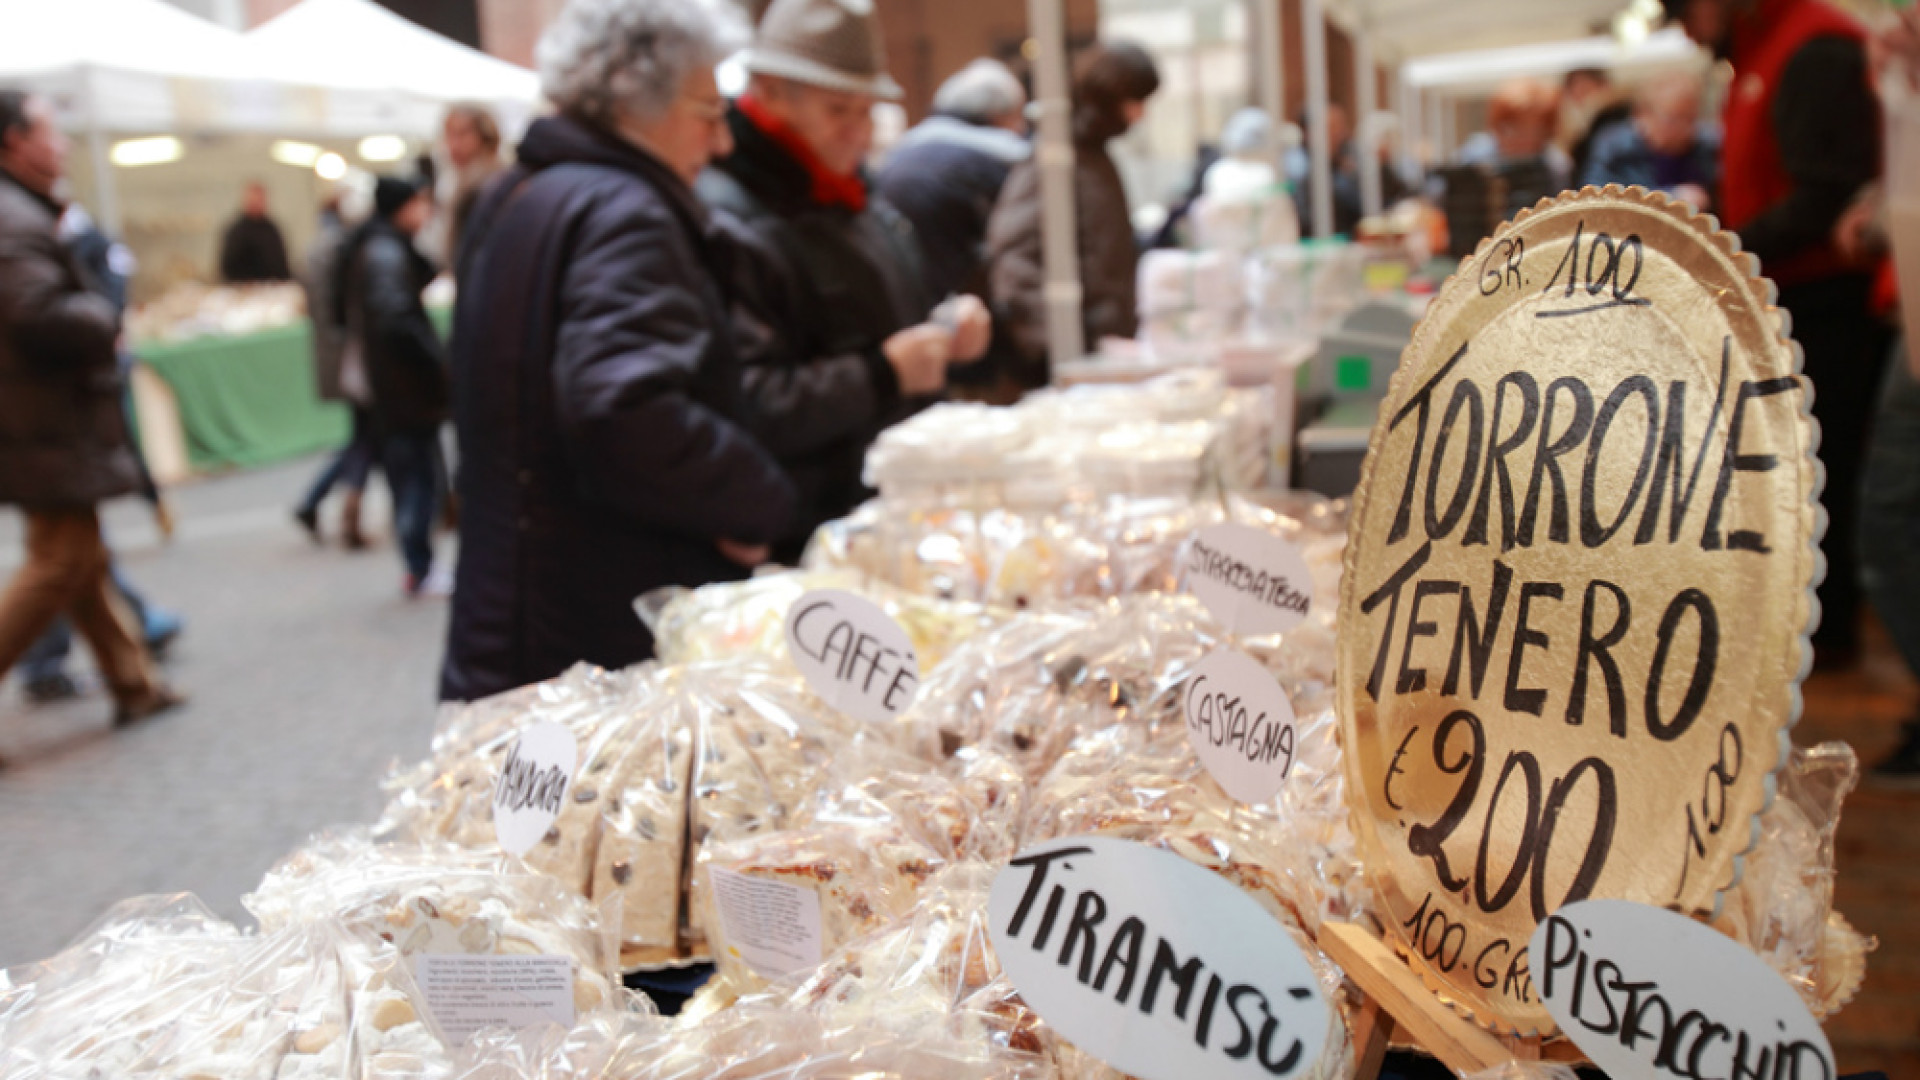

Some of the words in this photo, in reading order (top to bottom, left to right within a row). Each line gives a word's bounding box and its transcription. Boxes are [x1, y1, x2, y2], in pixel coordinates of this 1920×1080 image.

[1542, 219, 1645, 302] 100
[1388, 335, 1800, 554] TORRONE
[1361, 541, 1720, 742] TENERO
[1186, 674, 1295, 780] CASTAGNA
